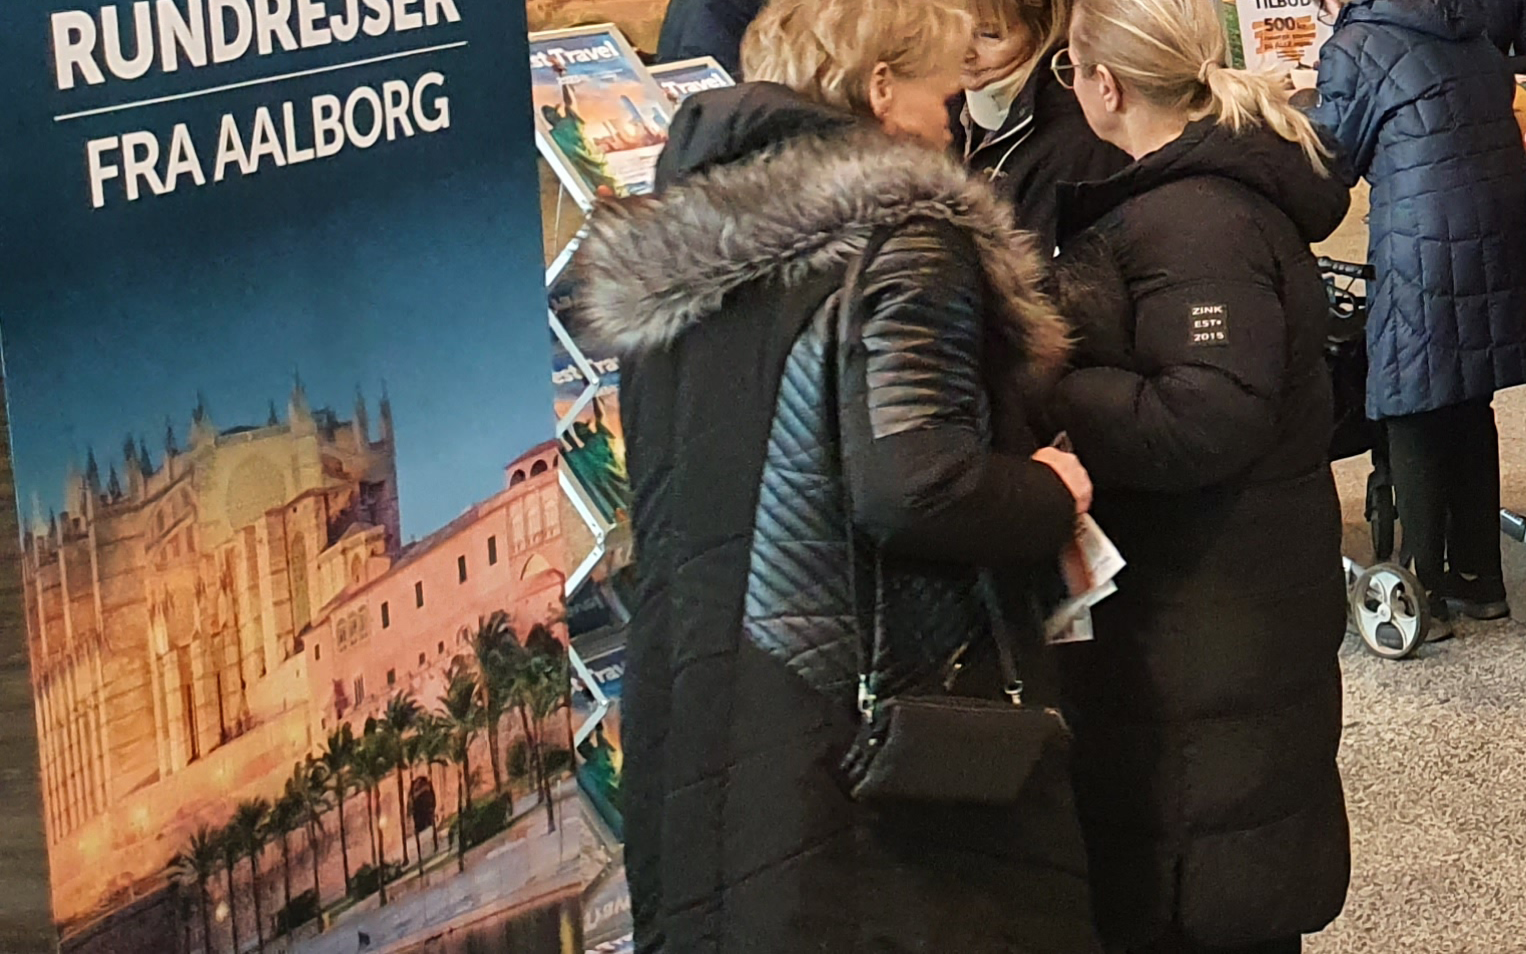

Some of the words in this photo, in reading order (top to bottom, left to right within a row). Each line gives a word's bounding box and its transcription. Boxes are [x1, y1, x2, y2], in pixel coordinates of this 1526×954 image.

[1264, 17, 1295, 32] 500
[547, 40, 619, 67] Travel
[661, 72, 727, 97] Travel
[87, 122, 206, 209] FRA
[212, 72, 450, 183] AALBORG
[1192, 306, 1223, 315] ZINK
[1193, 332, 1224, 342] 2015
